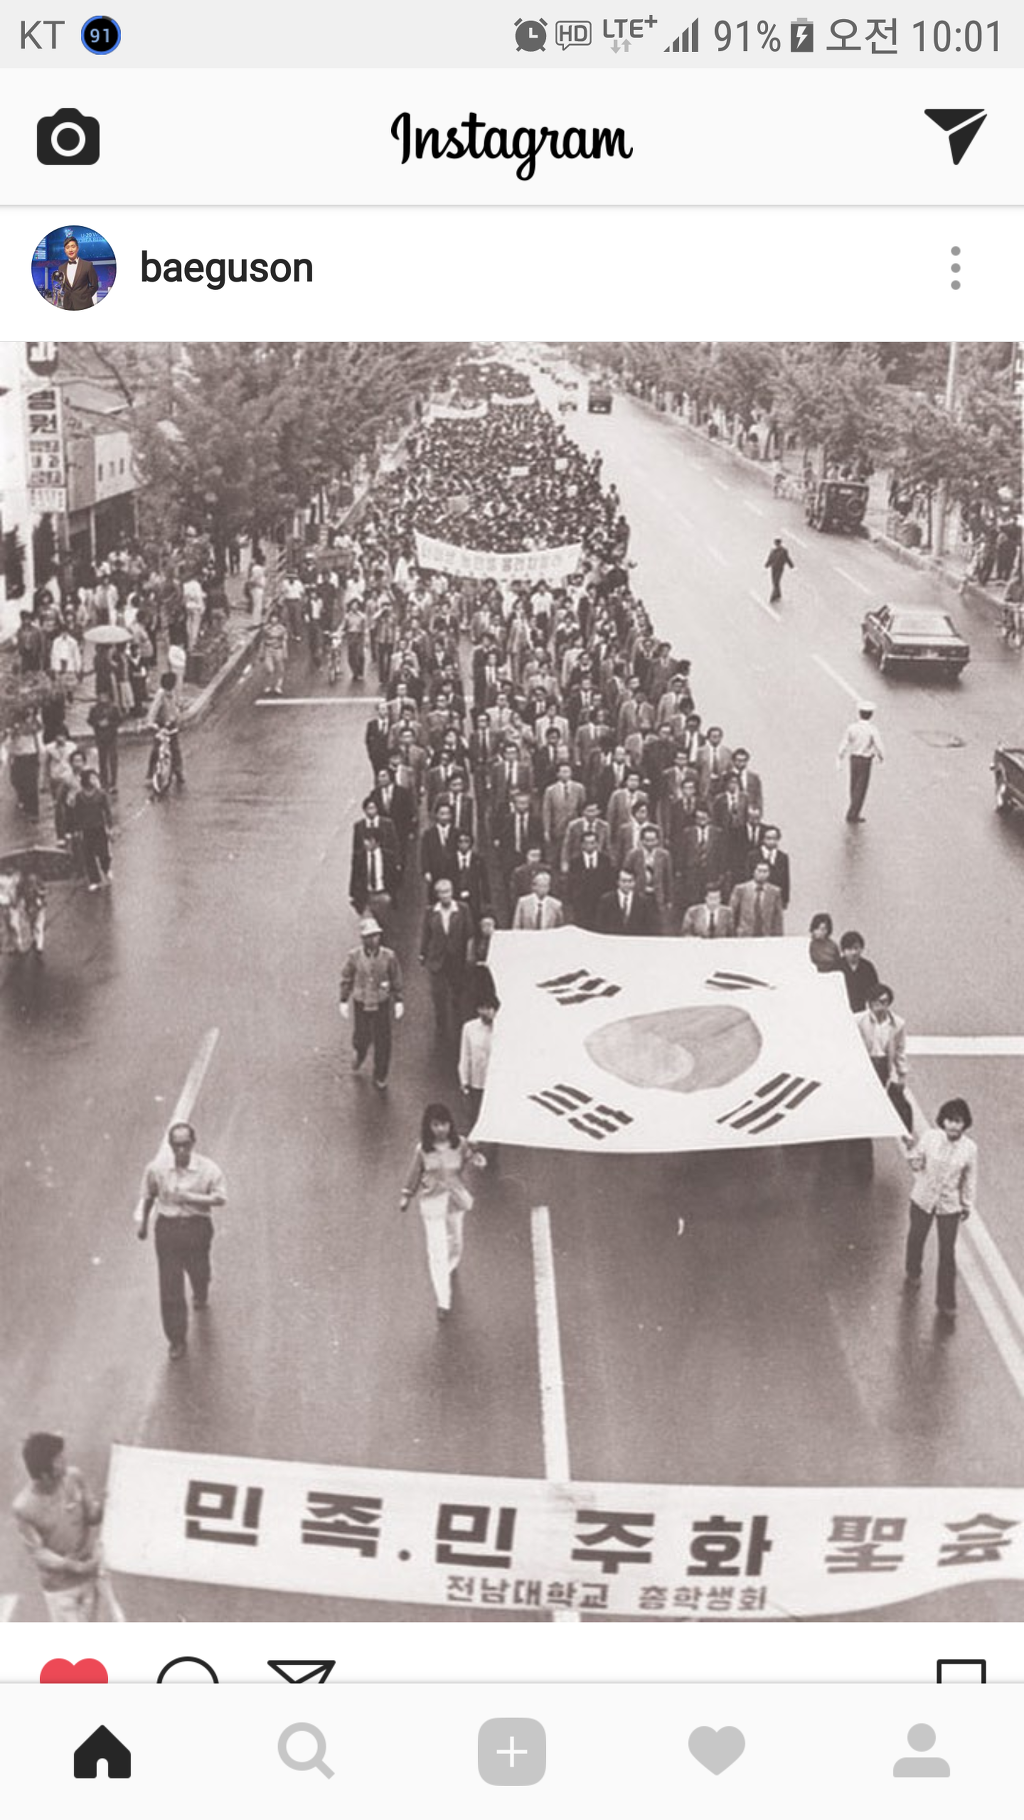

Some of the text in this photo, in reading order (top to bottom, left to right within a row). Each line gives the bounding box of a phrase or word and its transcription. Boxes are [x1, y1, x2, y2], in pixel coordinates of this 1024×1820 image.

[20, 20, 66, 50] KT
[89, 27, 112, 44] 91
[559, 25, 588, 43] HD
[714, 20, 782, 52] 91%
[826, 17, 999, 54] 오전 10:01
[390, 111, 634, 181] Instagram
[141, 250, 313, 291] baeguson
[446, 1574, 767, 1611] 전남대학교 총학생회
